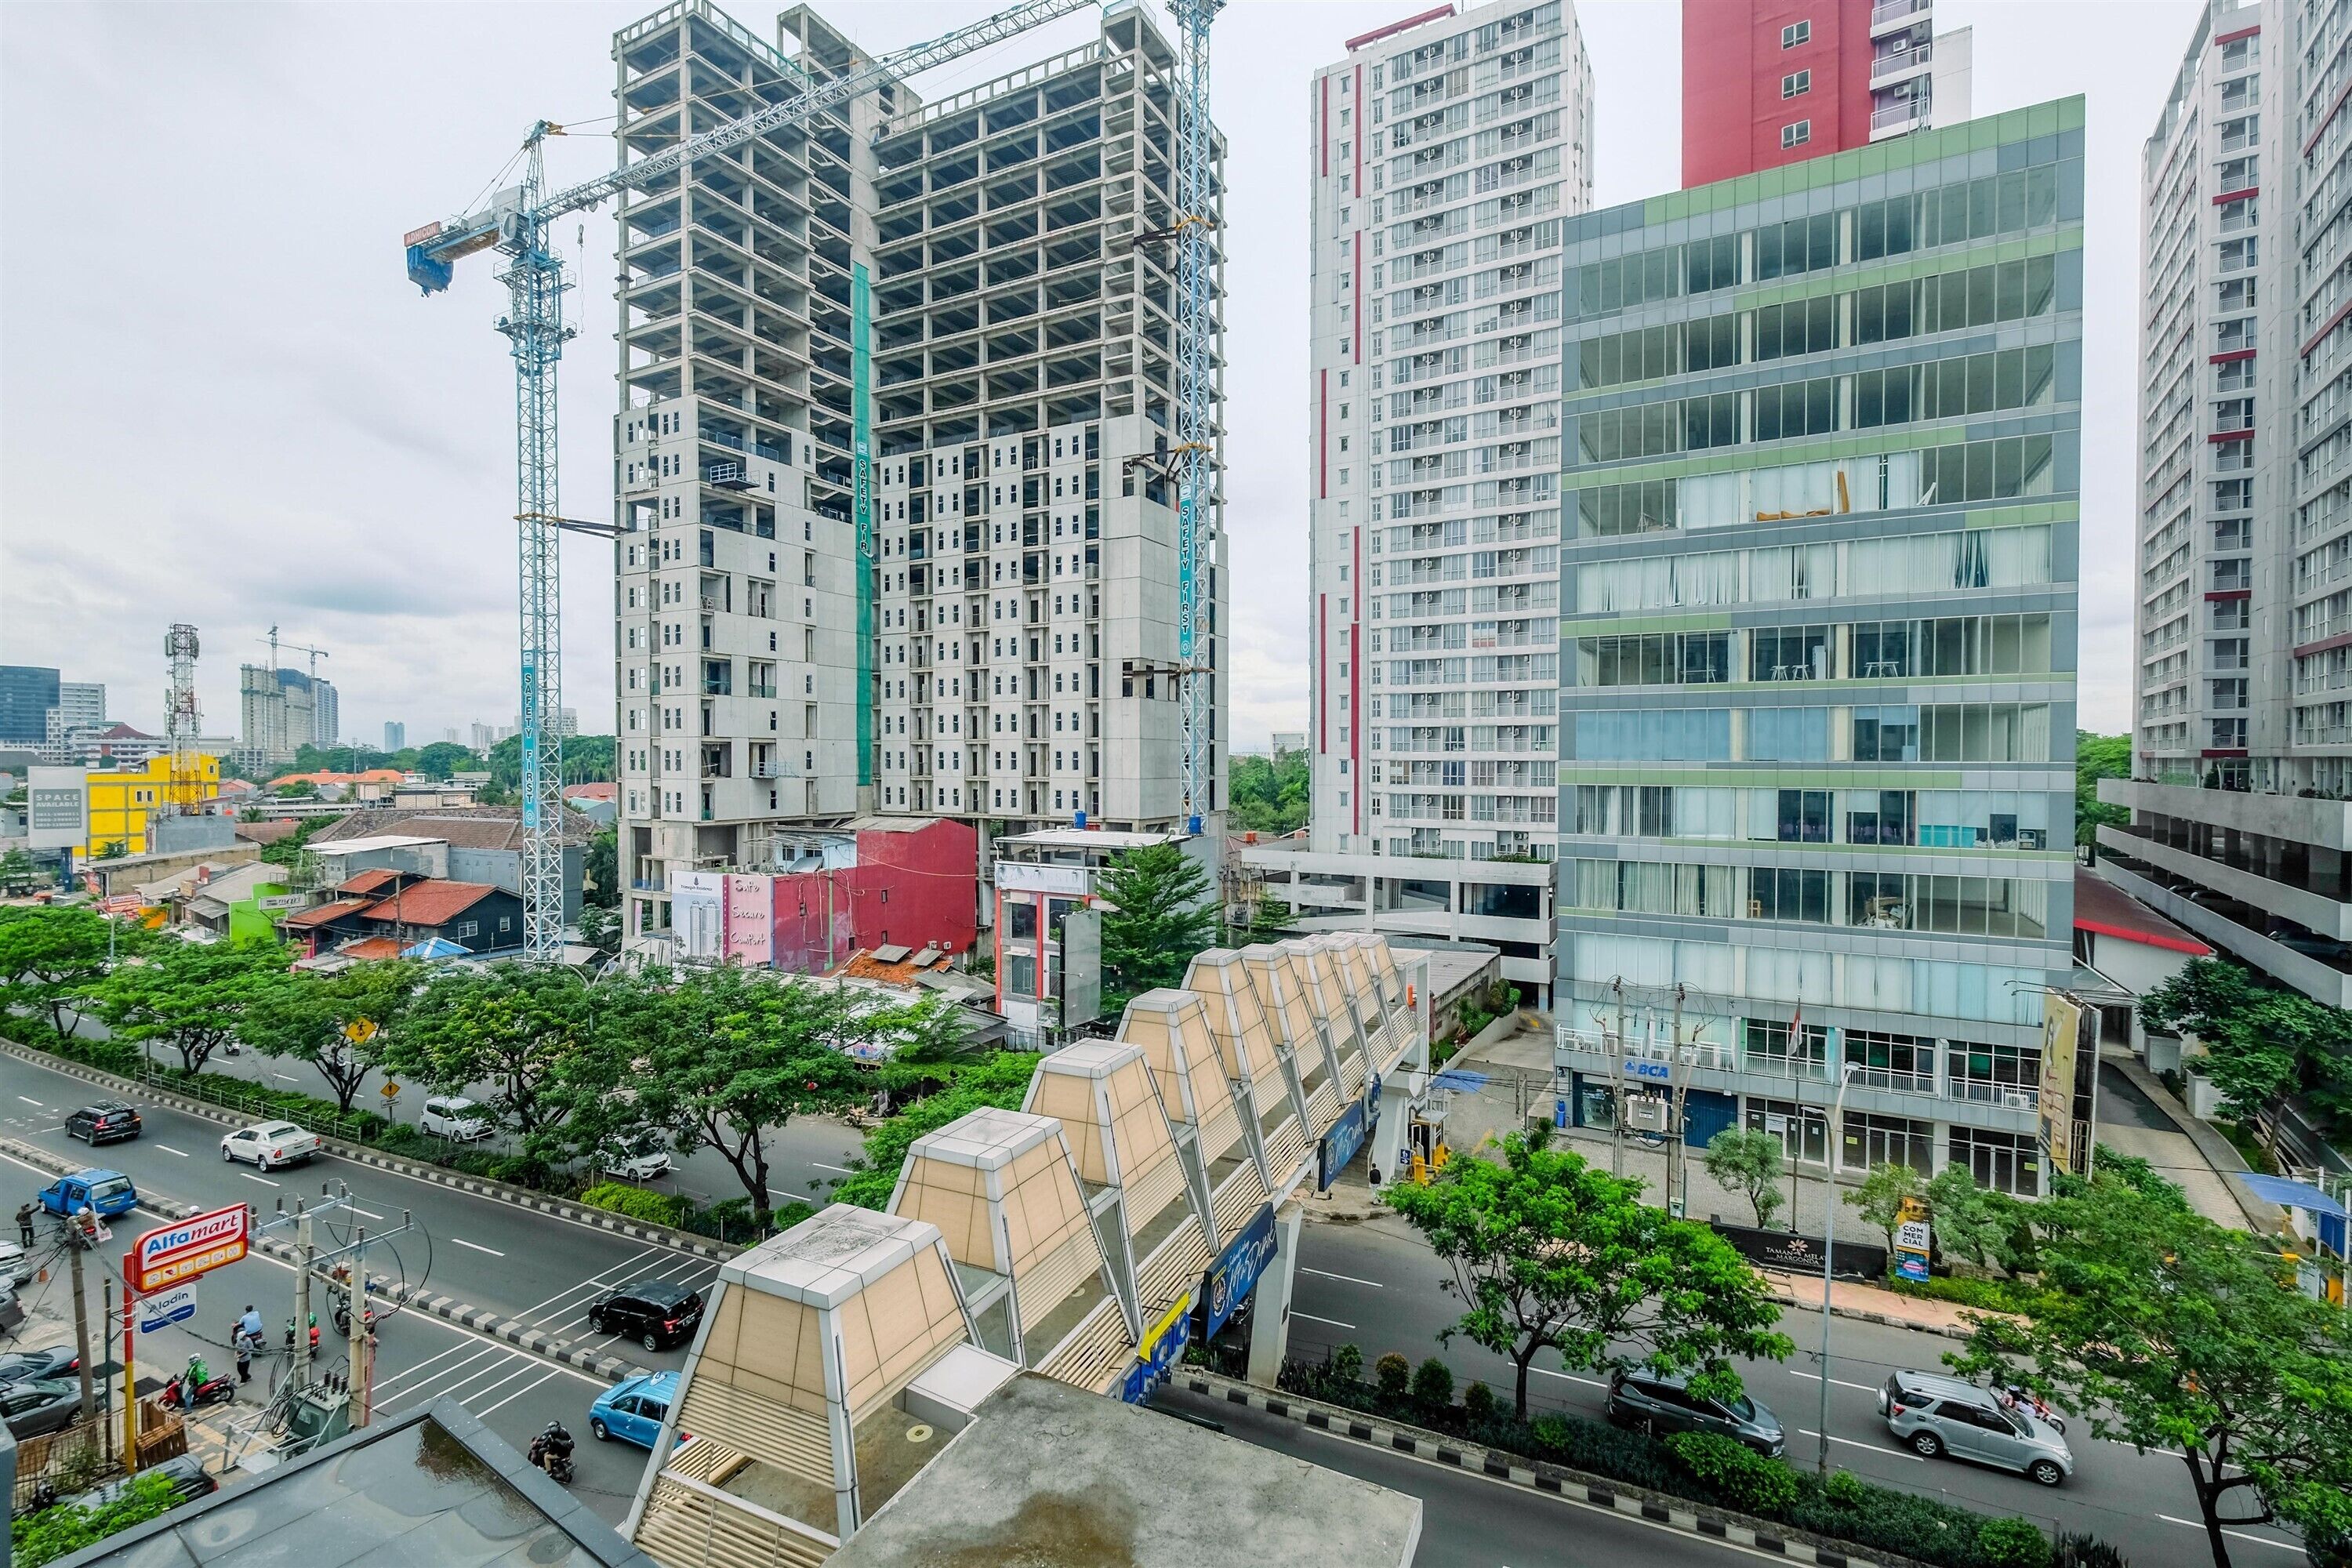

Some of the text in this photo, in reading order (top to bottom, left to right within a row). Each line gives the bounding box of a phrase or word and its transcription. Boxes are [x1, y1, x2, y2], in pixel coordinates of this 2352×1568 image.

[858, 459, 867, 514] SAFETY
[1181, 506, 1190, 570] SAFETY
[1181, 581, 1190, 634] FIRST
[524, 673, 533, 739] SAFETY
[524, 750, 535, 804] FIRST
[1637, 1064, 1668, 1078] BCA
[147, 1214, 239, 1254] Alfamart
[1903, 1225, 1924, 1234] COM
[1903, 1237, 1923, 1247] CIAL
[1904, 1232, 1923, 1240] MER
[1766, 1247, 1794, 1256] TAMAN
[1776, 1254, 1820, 1265] MARGONDA
